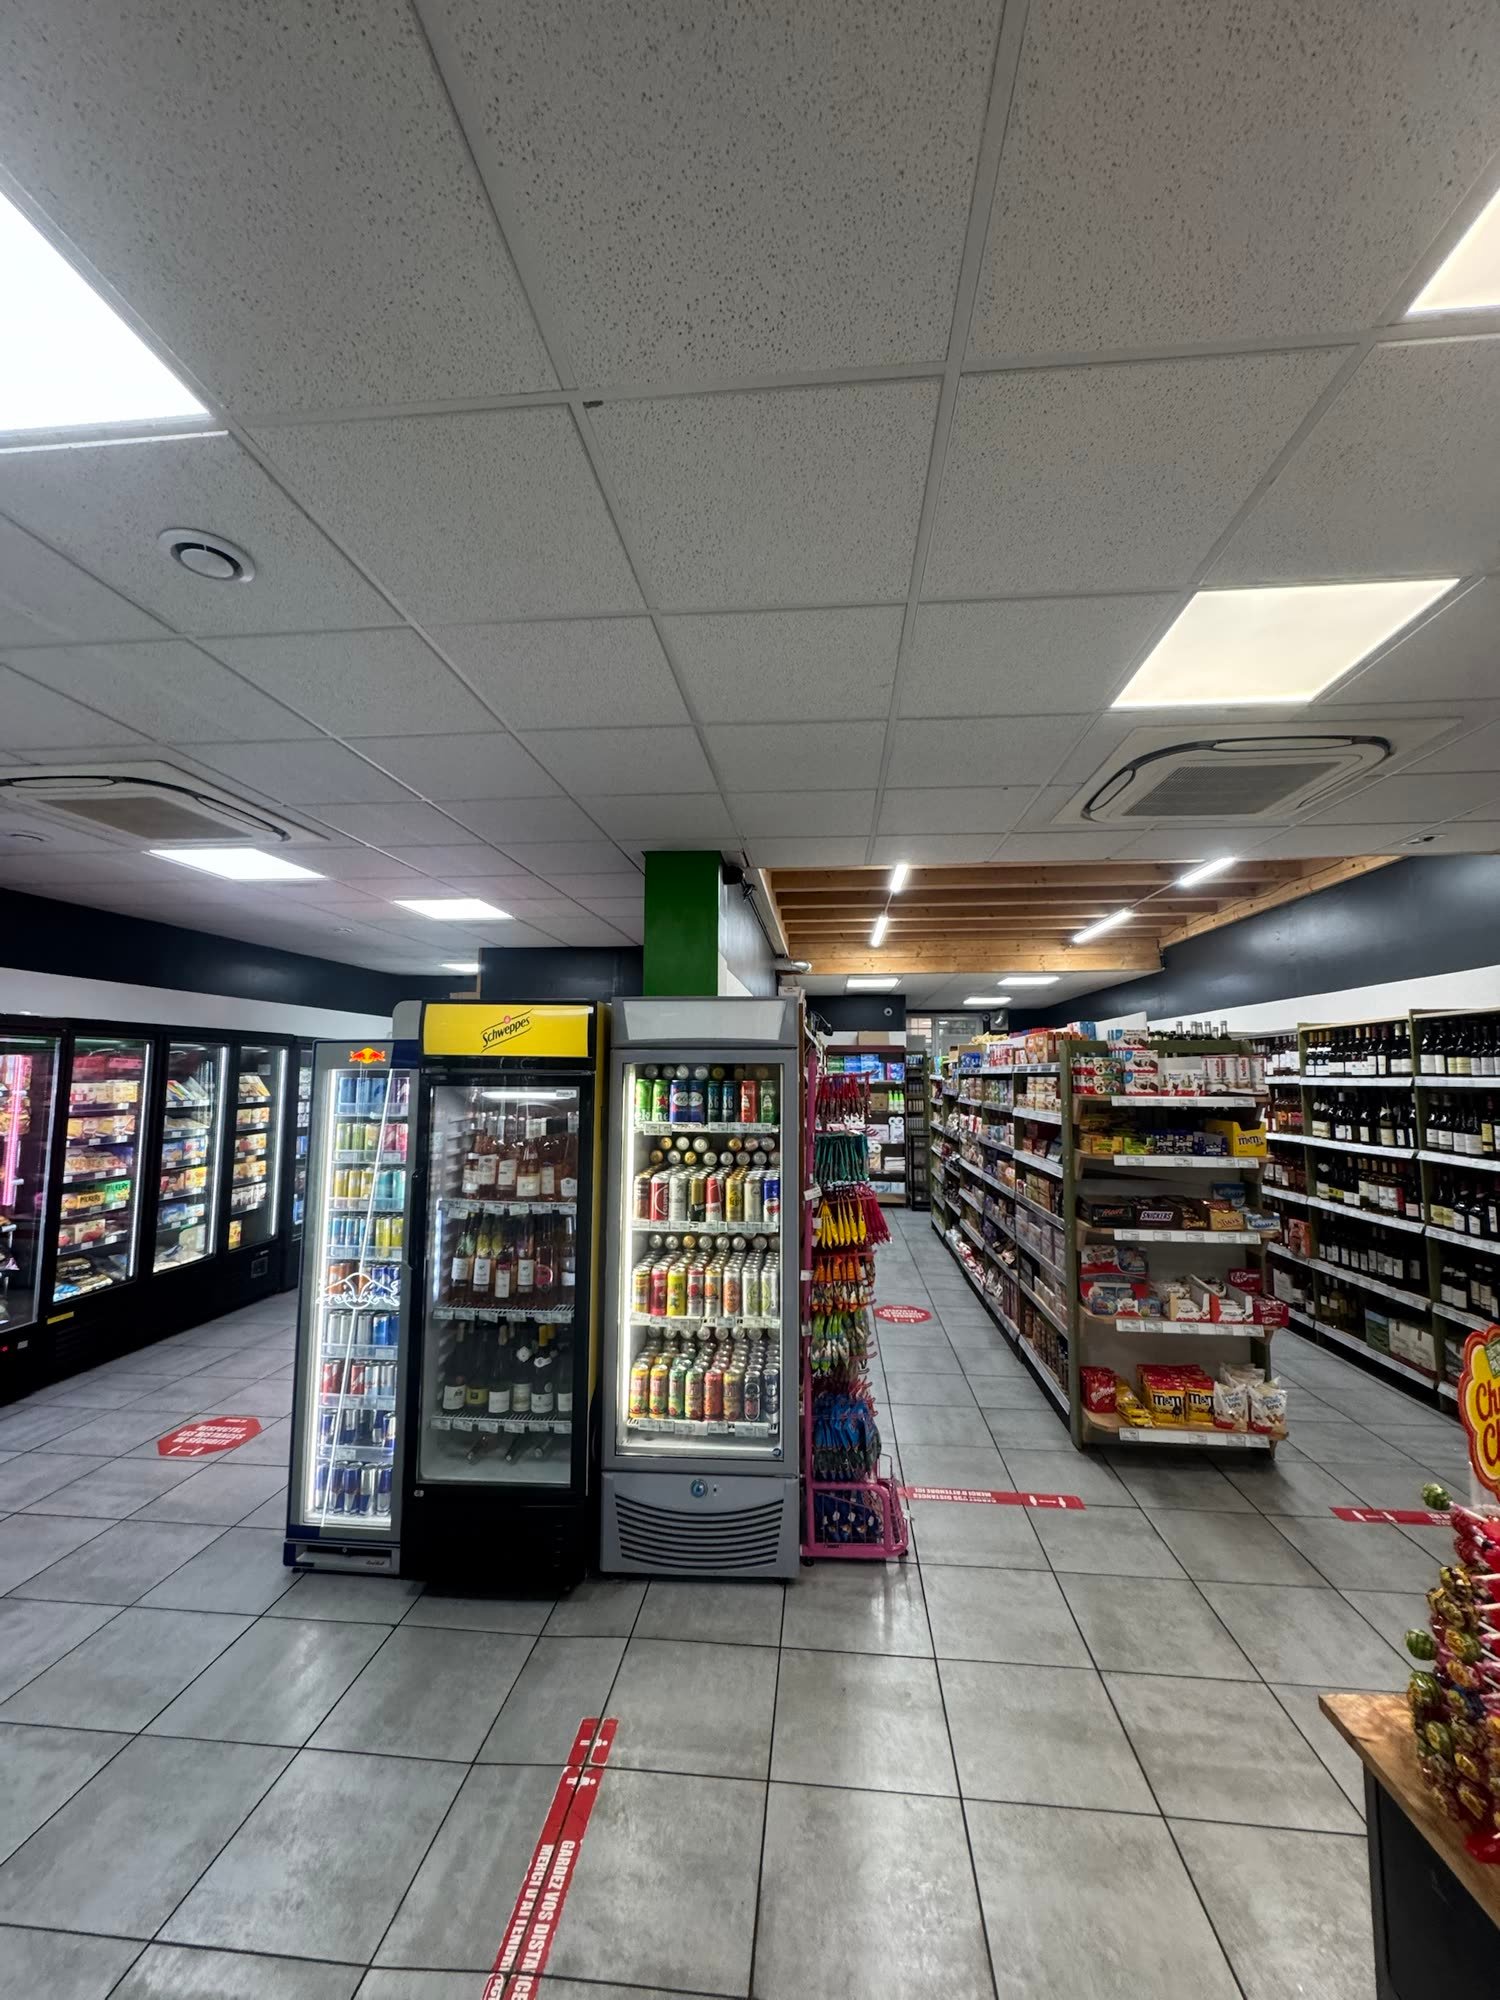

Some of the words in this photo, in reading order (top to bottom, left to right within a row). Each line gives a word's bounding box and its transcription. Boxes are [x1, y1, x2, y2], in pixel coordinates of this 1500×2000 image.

[482, 1016, 531, 1048] Schweppes
[1142, 1211, 1172, 1220] SNICKERS
[913, 1493, 952, 1501] DISTANCES
[529, 1844, 554, 1887] MERCI
[548, 1840, 575, 1889] GARDEZ
[538, 1891, 561, 1921] VOS
